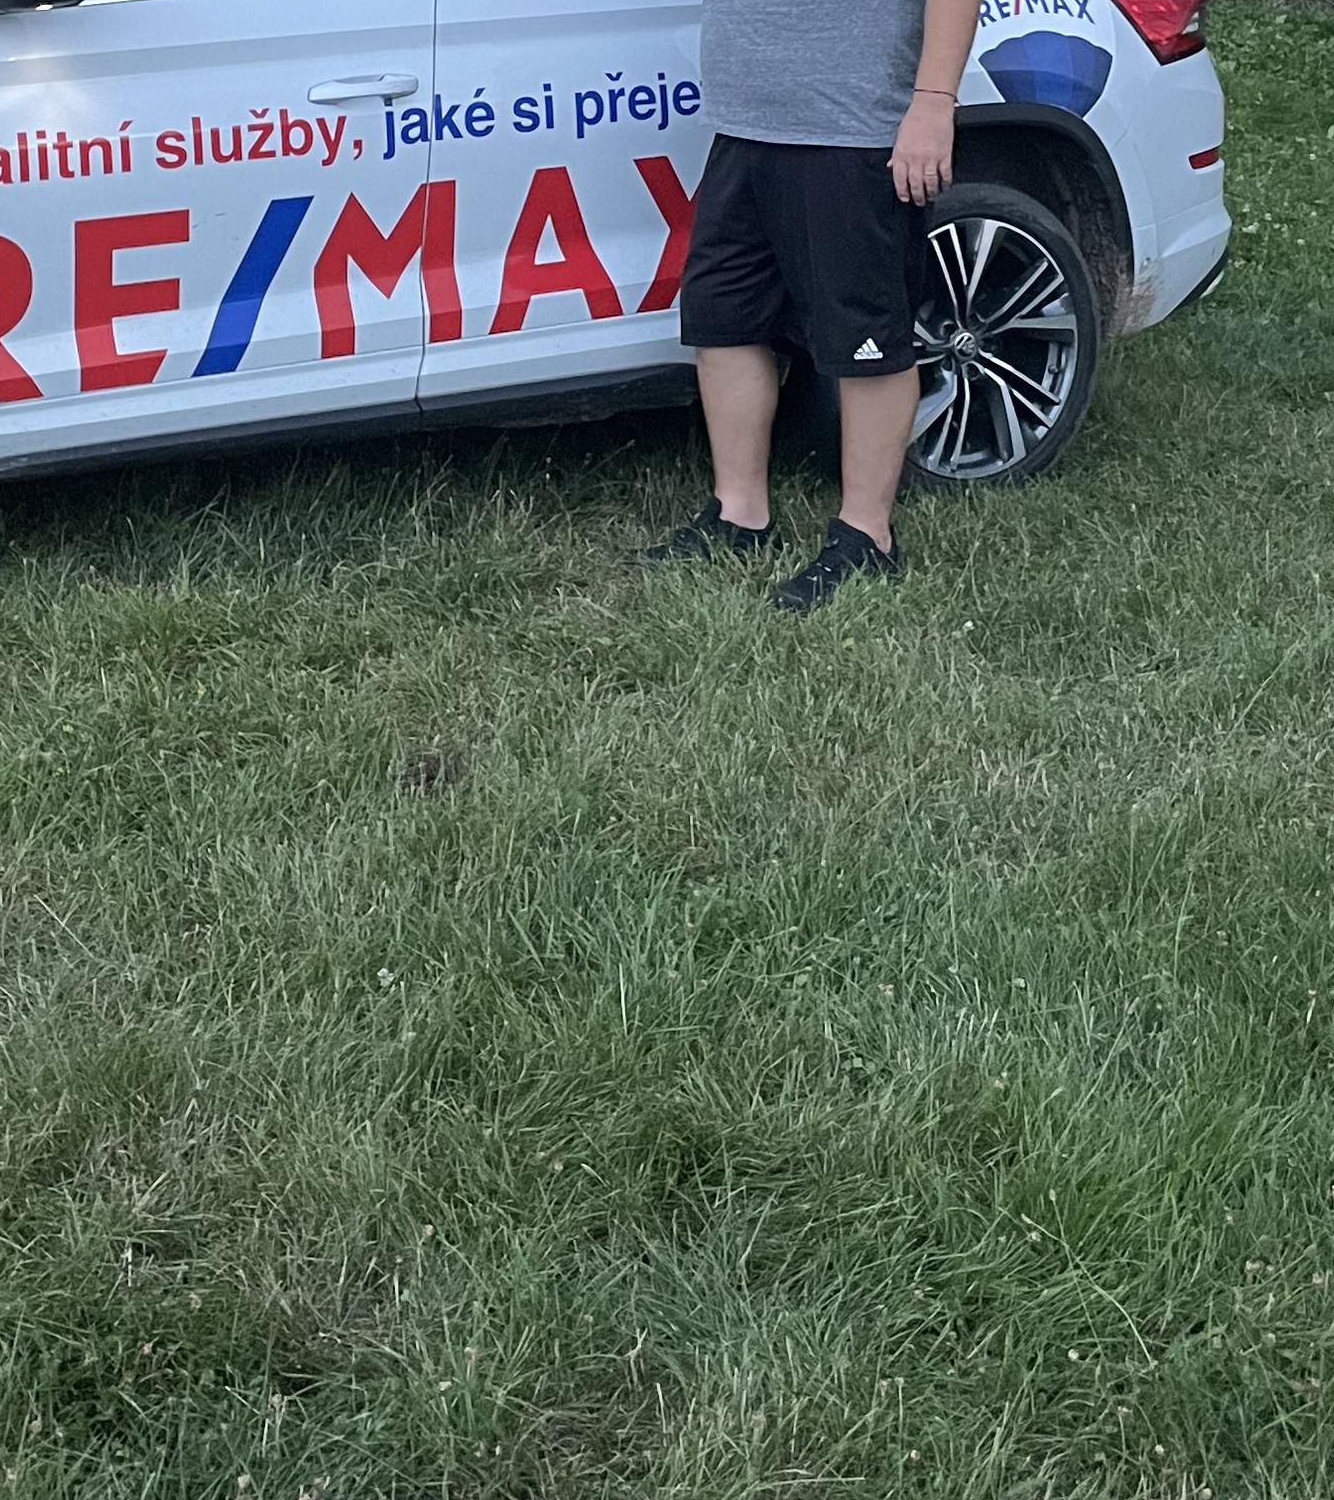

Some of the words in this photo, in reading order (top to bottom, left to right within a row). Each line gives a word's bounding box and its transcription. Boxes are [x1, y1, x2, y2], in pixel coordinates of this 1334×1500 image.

[155, 107, 364, 167] služby,
[383, 87, 495, 160] jaké
[512, 83, 555, 133] si
[575, 71, 703, 139] přeje
